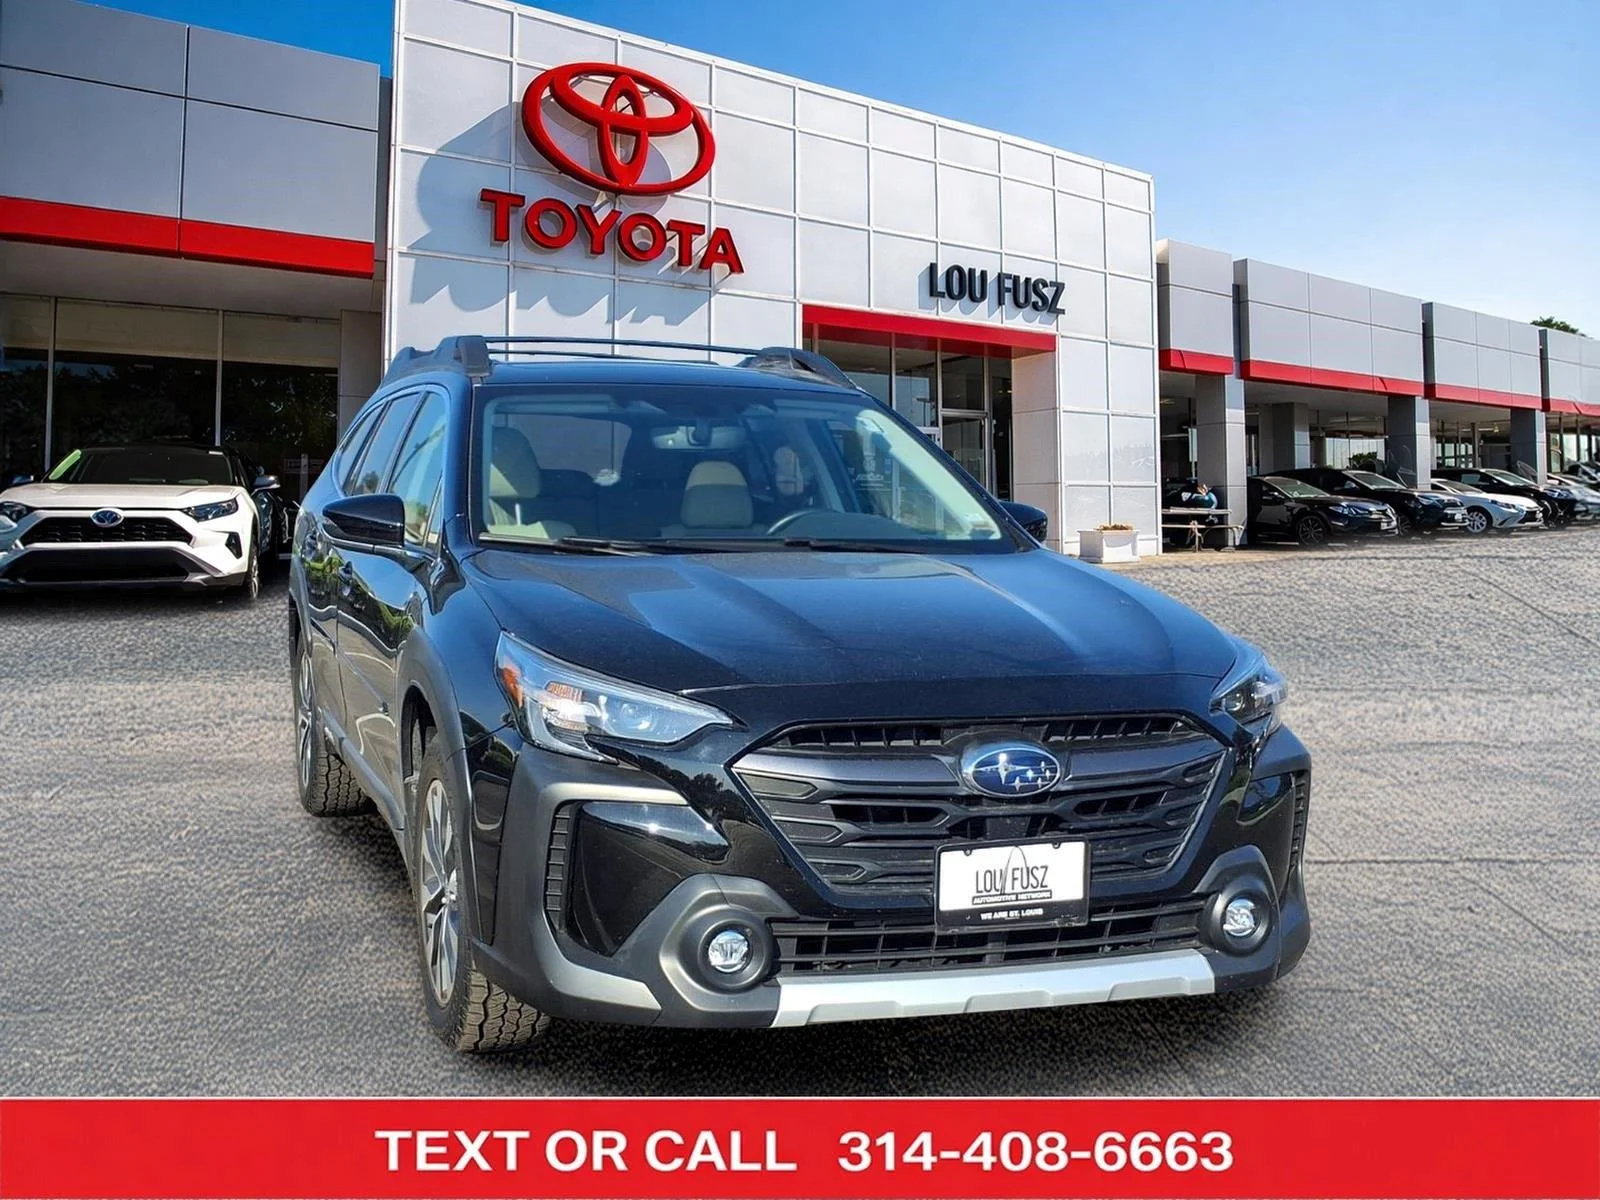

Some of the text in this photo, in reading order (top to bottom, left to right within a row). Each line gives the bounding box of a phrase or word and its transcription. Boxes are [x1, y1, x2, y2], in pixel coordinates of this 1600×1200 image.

[480, 188, 744, 274] TOYOTA
[929, 262, 1066, 315] LOU FUSZ
[976, 866, 1048, 893] LOU FUSZ
[980, 912, 993, 920] WE
[1021, 908, 1043, 916] LOUIS
